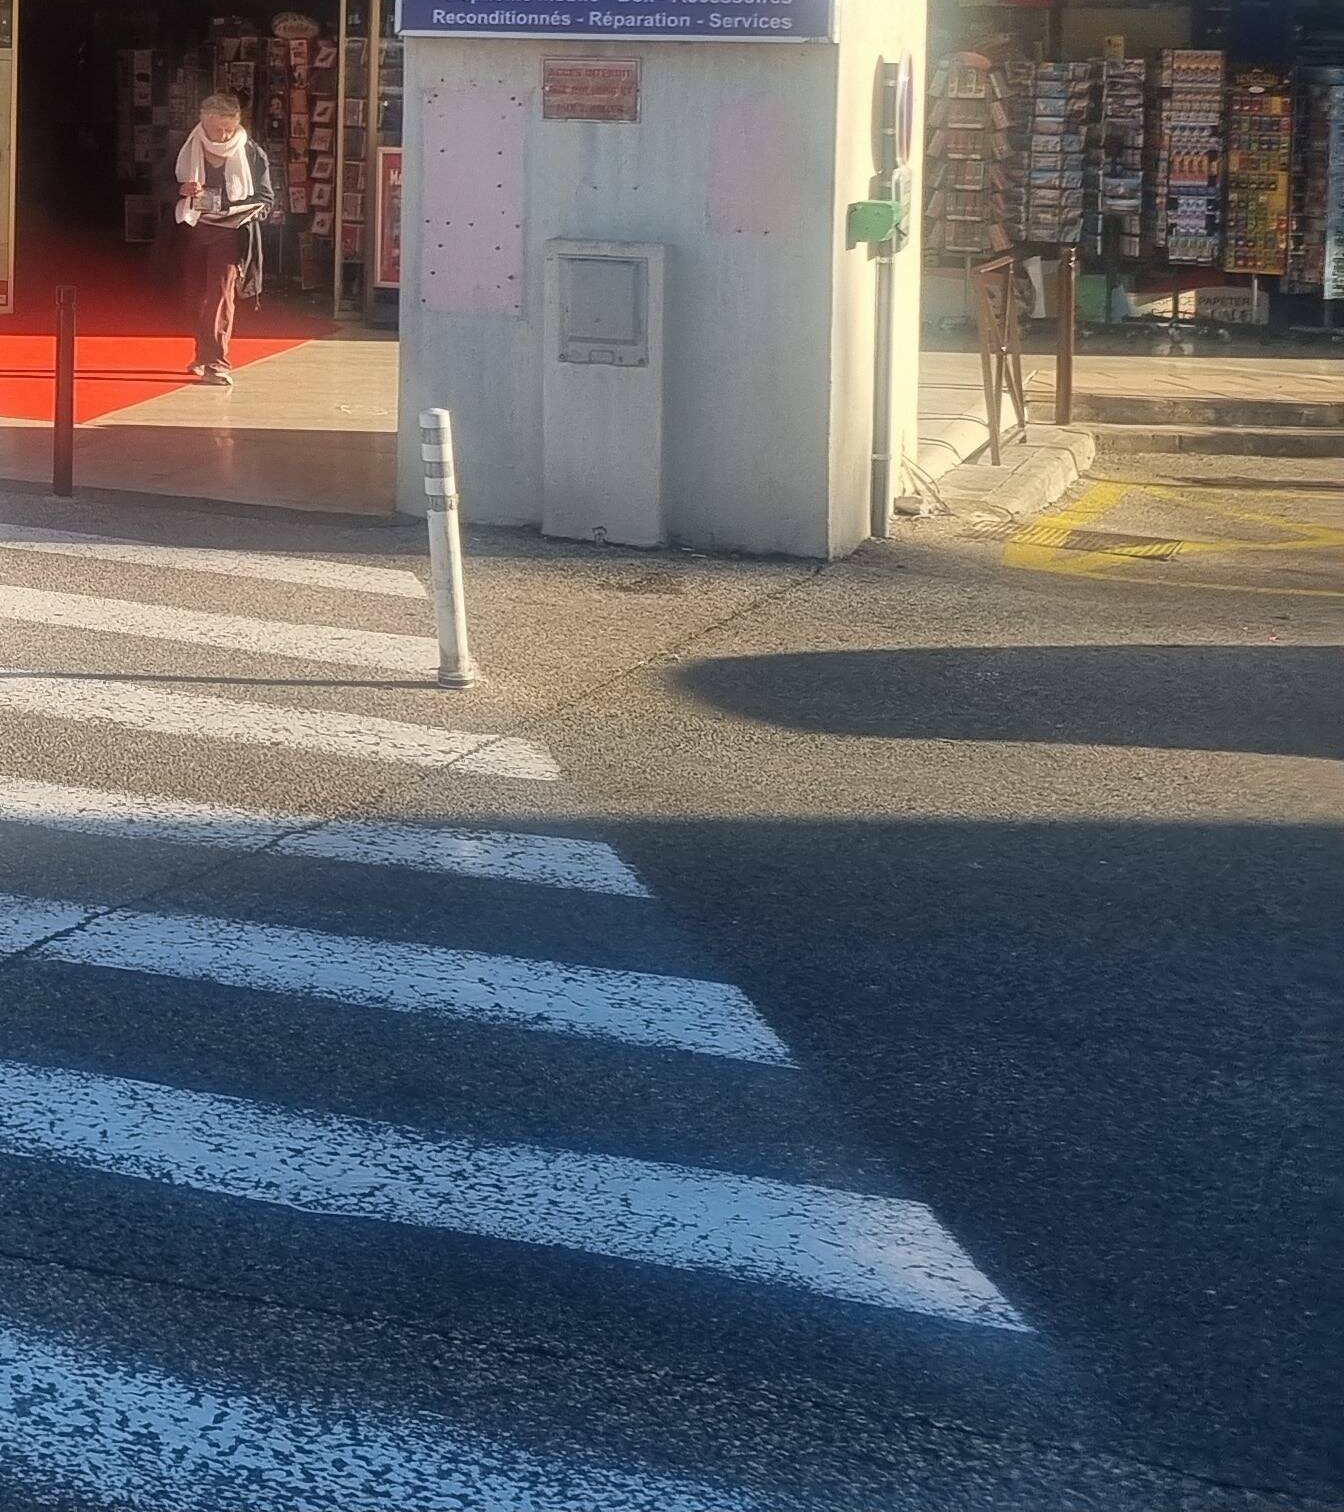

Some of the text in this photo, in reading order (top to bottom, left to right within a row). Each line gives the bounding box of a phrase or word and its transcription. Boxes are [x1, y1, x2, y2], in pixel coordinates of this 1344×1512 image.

[432, 9, 571, 26] Reconditionnés
[589, 10, 691, 30] Réparation
[709, 12, 793, 29] Services
